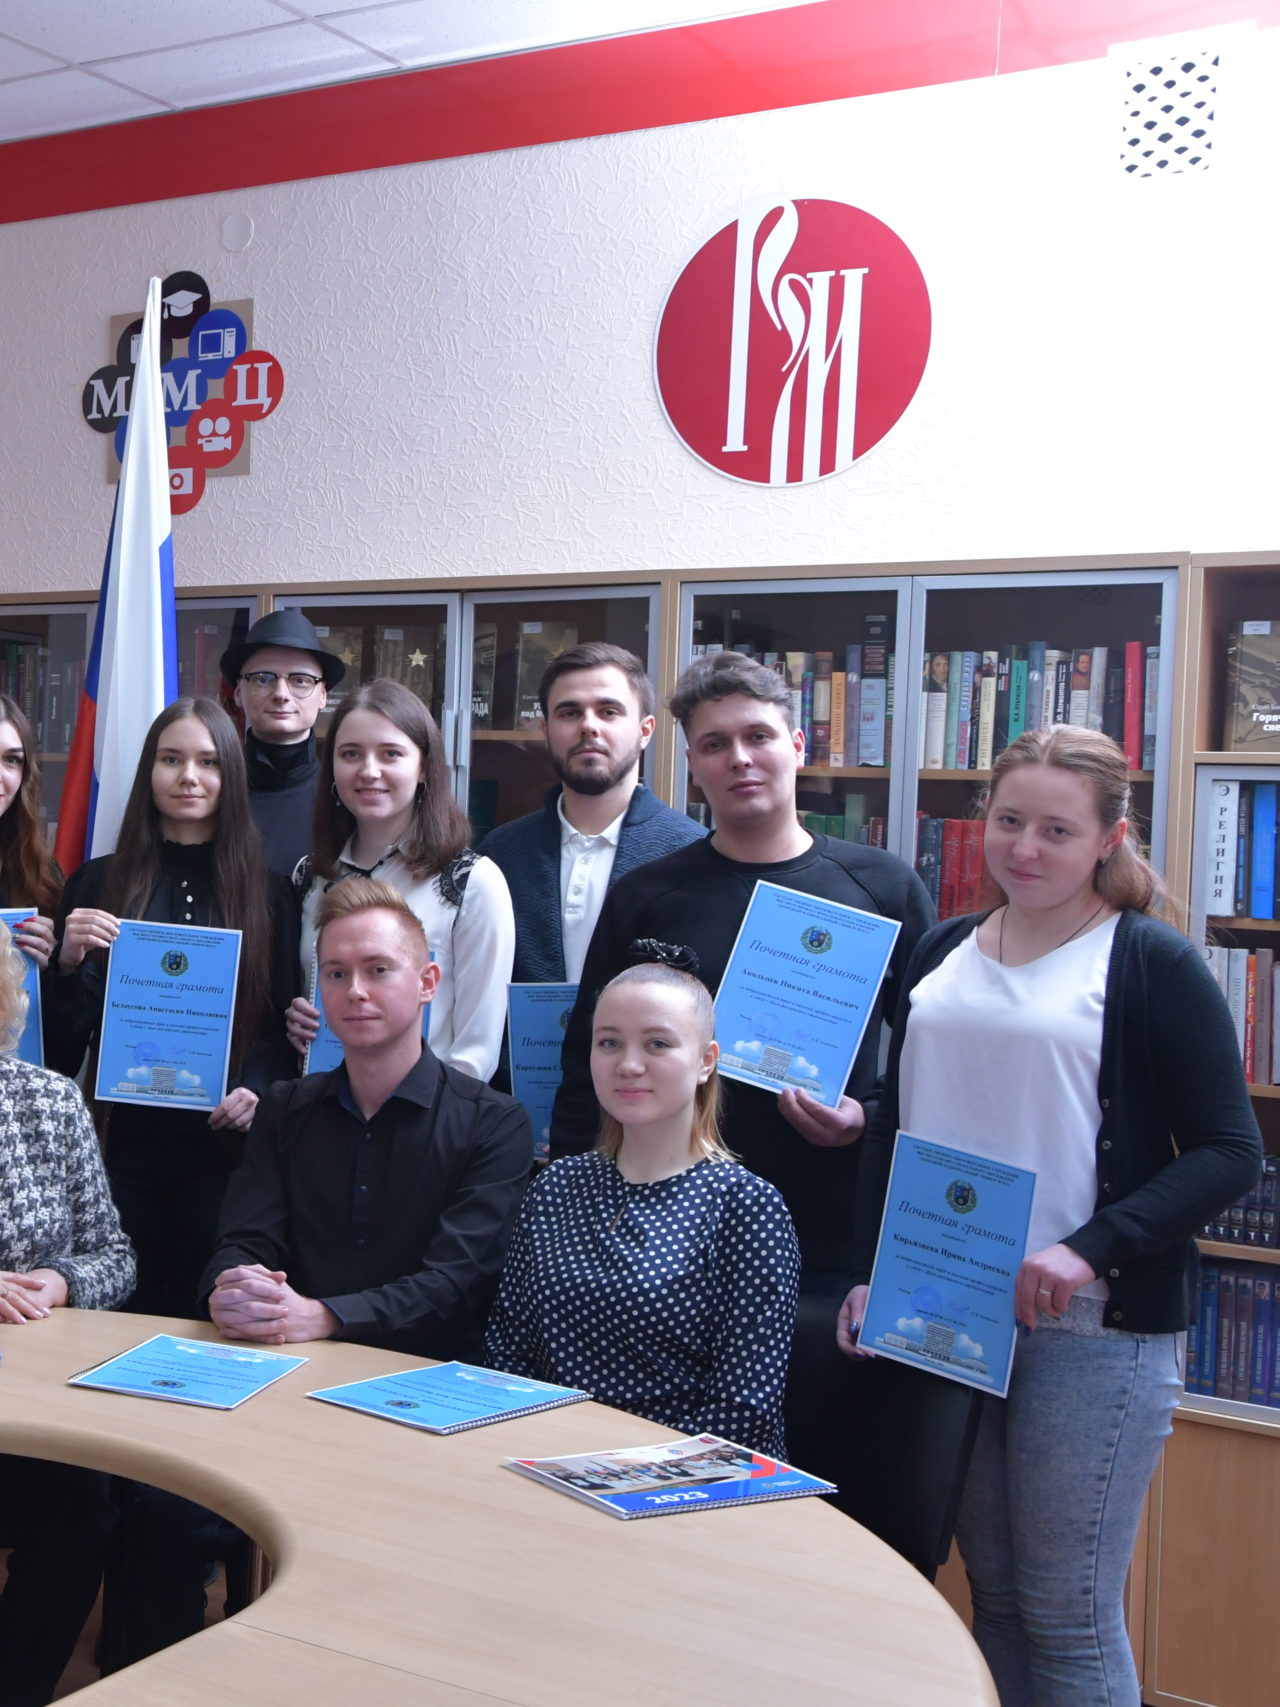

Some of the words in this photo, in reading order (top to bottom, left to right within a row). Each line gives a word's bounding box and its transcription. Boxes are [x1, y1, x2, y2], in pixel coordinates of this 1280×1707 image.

[471, 702, 489, 717] РАДА
[1212, 806, 1228, 899] РЕЛИГИЯ
[749, 939, 810, 967] Почетная
[812, 960, 868, 985] грамота
[119, 975, 173, 990] Почетная
[176, 984, 224, 995] грамота
[521, 1037, 561, 1048] Почет
[898, 1199, 959, 1229] Почетная
[960, 1220, 1016, 1248] грамота
[645, 1490, 711, 1505] 2023
